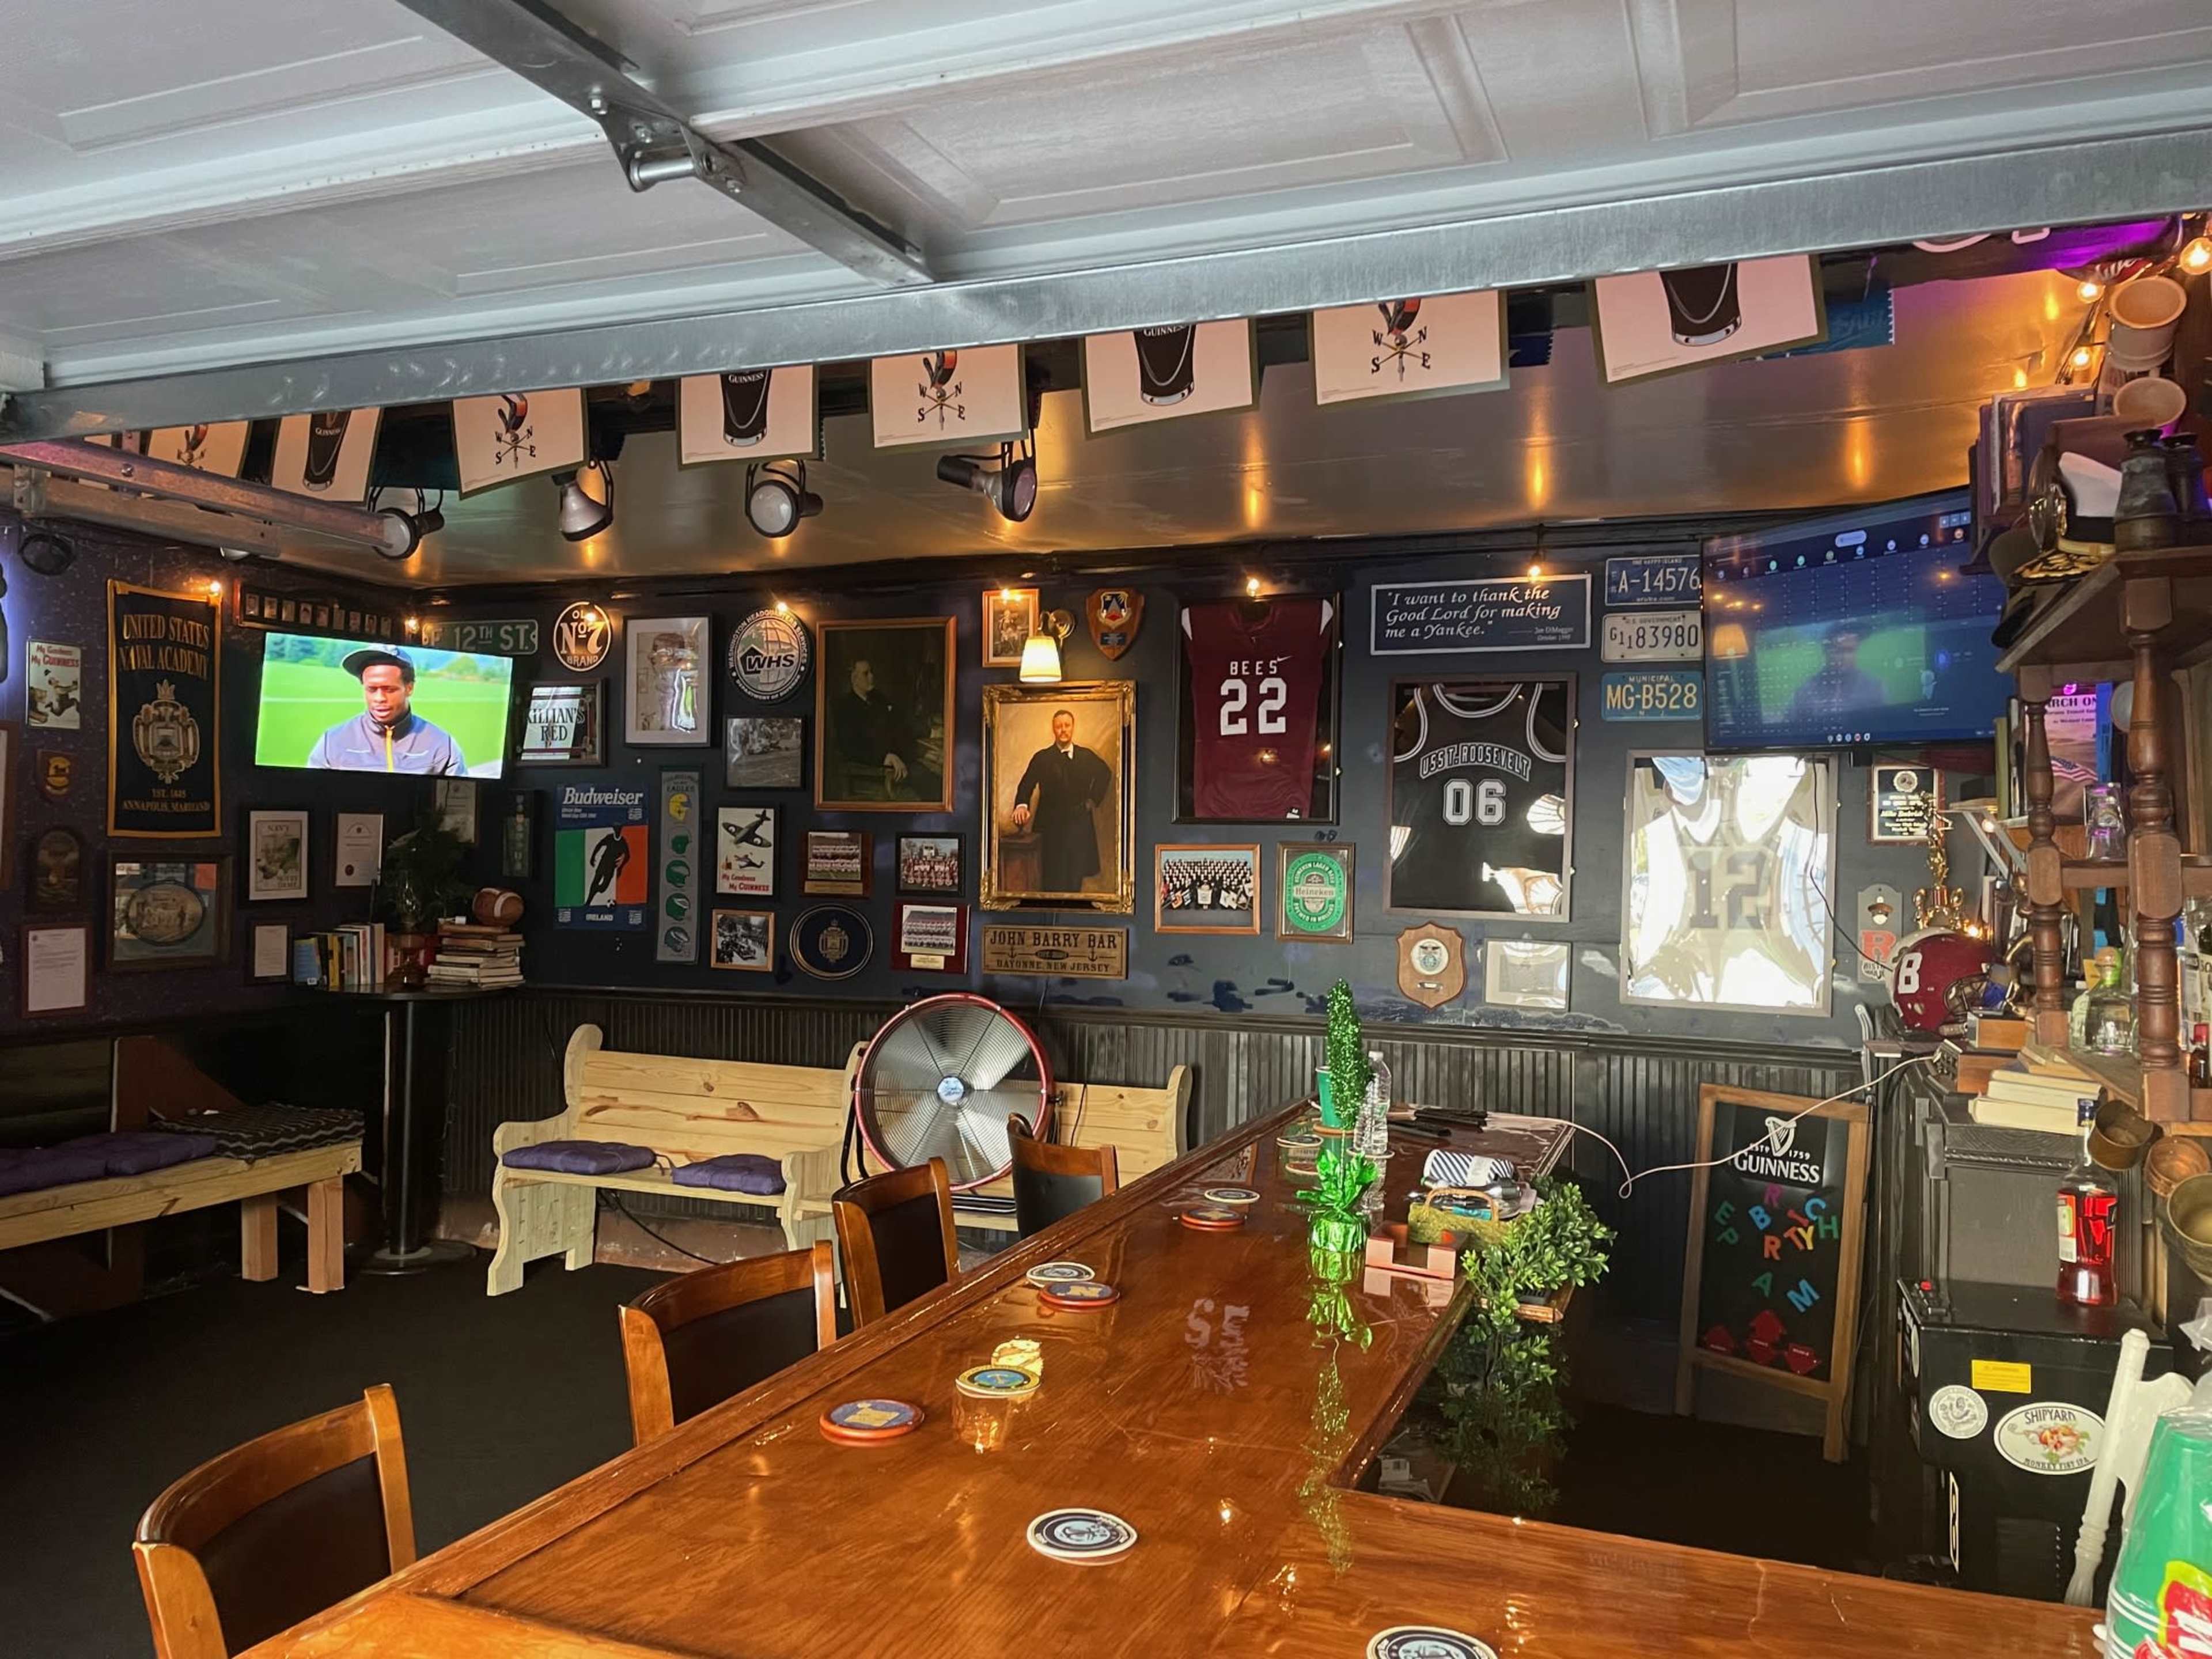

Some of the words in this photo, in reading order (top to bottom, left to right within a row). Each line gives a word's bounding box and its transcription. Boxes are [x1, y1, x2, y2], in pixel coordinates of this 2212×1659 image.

[1372, 329, 1383, 346] W
[1418, 326, 1427, 344] N
[1372, 357, 1380, 374] S
[1422, 352, 1430, 369] E
[918, 407, 925, 423] S
[1618, 567, 1700, 593] A-14576
[1404, 593, 1444, 605] want
[1451, 592, 1467, 603] to
[1473, 586, 1522, 603] thank
[1524, 585, 1550, 600] the
[747, 608, 797, 627] HEADQUTERS
[1387, 607, 1430, 626] Good
[1431, 605, 1472, 620] Lord
[1469, 605, 1497, 623] for
[1502, 602, 1562, 620] making
[123, 614, 165, 639] UNITED
[169, 616, 210, 650] STATES
[454, 626, 493, 650] 12TH
[500, 624, 529, 650] ST.
[1385, 628, 1406, 638] me
[1411, 628, 1420, 637] a
[119, 645, 155, 671] NAVAL
[157, 646, 209, 681] ACADEMY
[567, 656, 599, 666] BRAND
[747, 654, 795, 671] WHS
[1230, 660, 1277, 675] BEES
[1606, 683, 1697, 710] MG-B528
[1221, 677, 1286, 736] 22
[541, 726, 568, 741] RED
[1421, 749, 1445, 777] USS
[1460, 744, 1530, 780] ROOSEVELT
[562, 787, 644, 805] Budweiser
[1443, 779, 1506, 825] 06
[739, 882, 770, 891] GUINNESS
[1295, 888, 1334, 896] Heineken
[990, 930, 1025, 945] JOHN
[1033, 932, 1080, 948] BARRY
[1088, 934, 1117, 949] BAR
[1046, 961, 1066, 970] NEW
[1070, 963, 1111, 972] JERSEY
[1789, 1150, 1810, 1160] 1759
[1734, 1152, 1820, 1183] GUINNESS
[2025, 1410, 2076, 1425] SHIPYARD
[2025, 1457, 2056, 1469] MONKEY
